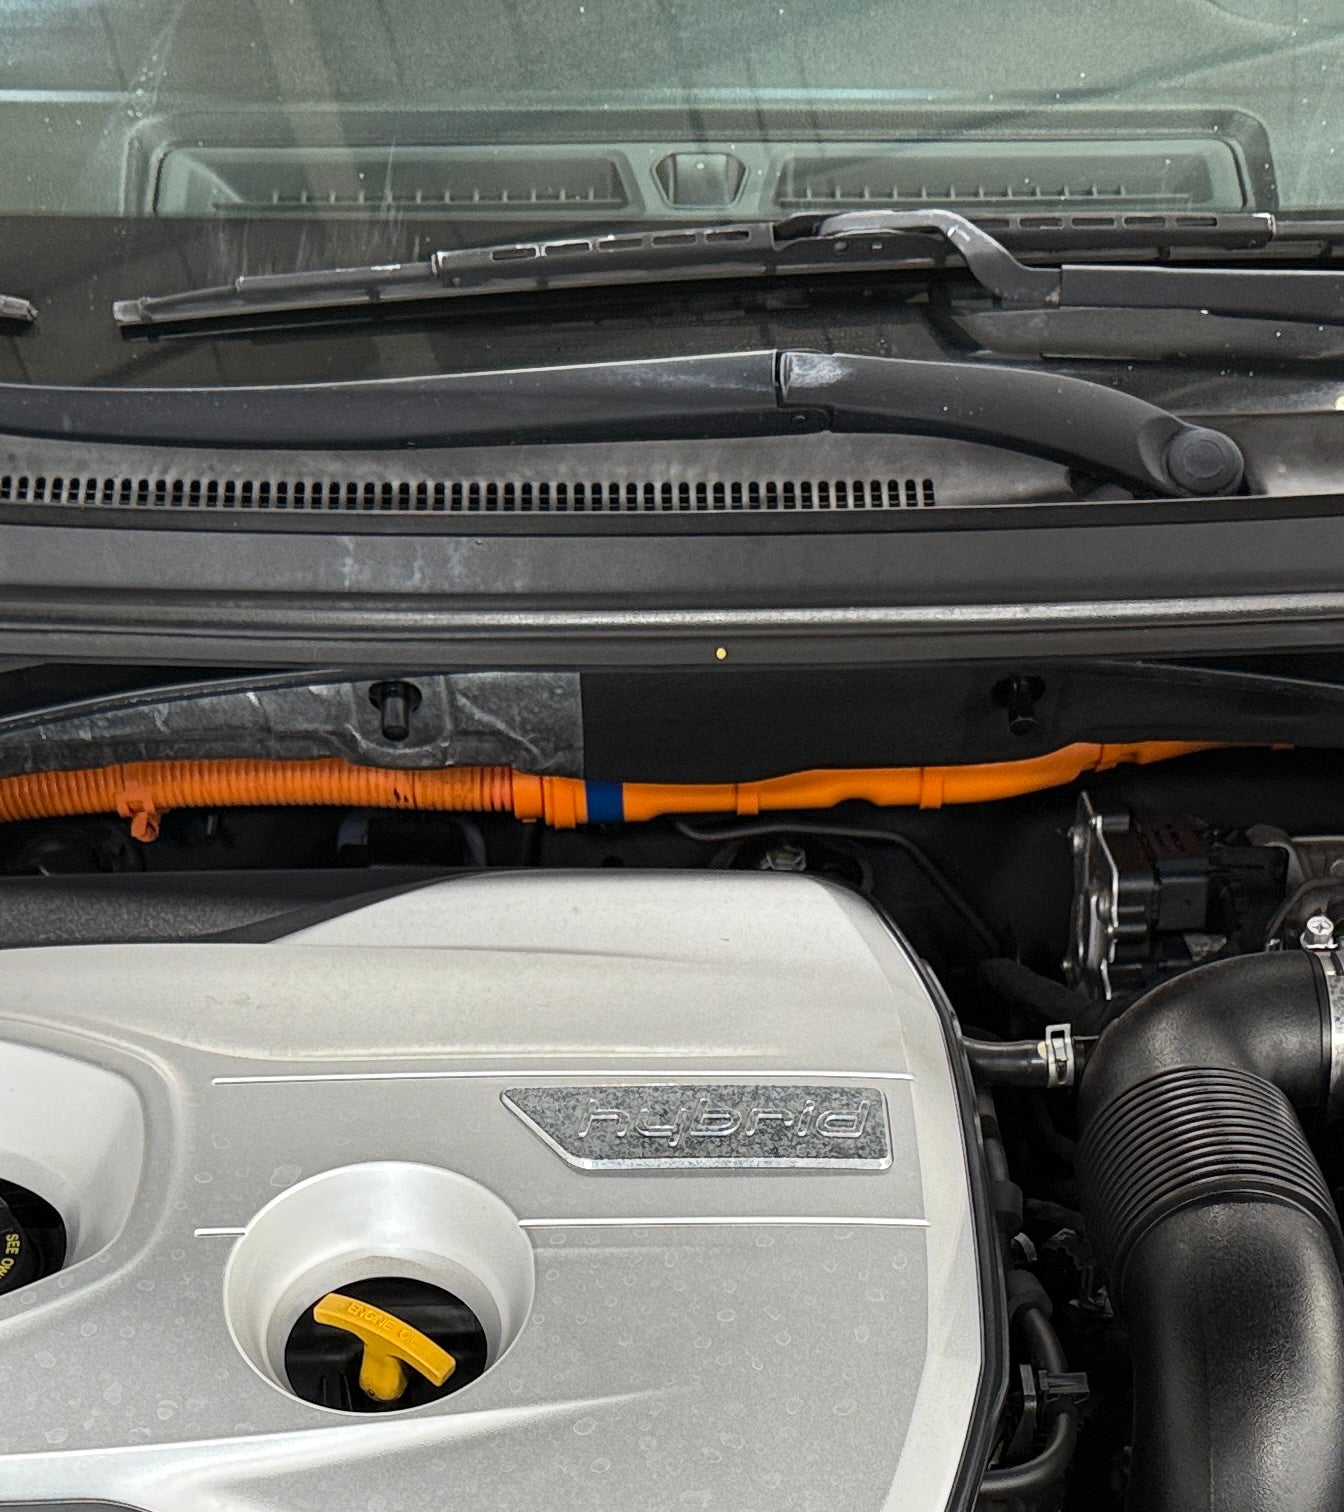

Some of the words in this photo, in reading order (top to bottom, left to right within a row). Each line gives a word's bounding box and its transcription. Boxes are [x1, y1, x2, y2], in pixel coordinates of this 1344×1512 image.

[577, 1097, 870, 1147] hybrid
[5, 1233, 21, 1255] SEE
[347, 1302, 395, 1331] ENGINE
[397, 1328, 419, 1347] OIL
